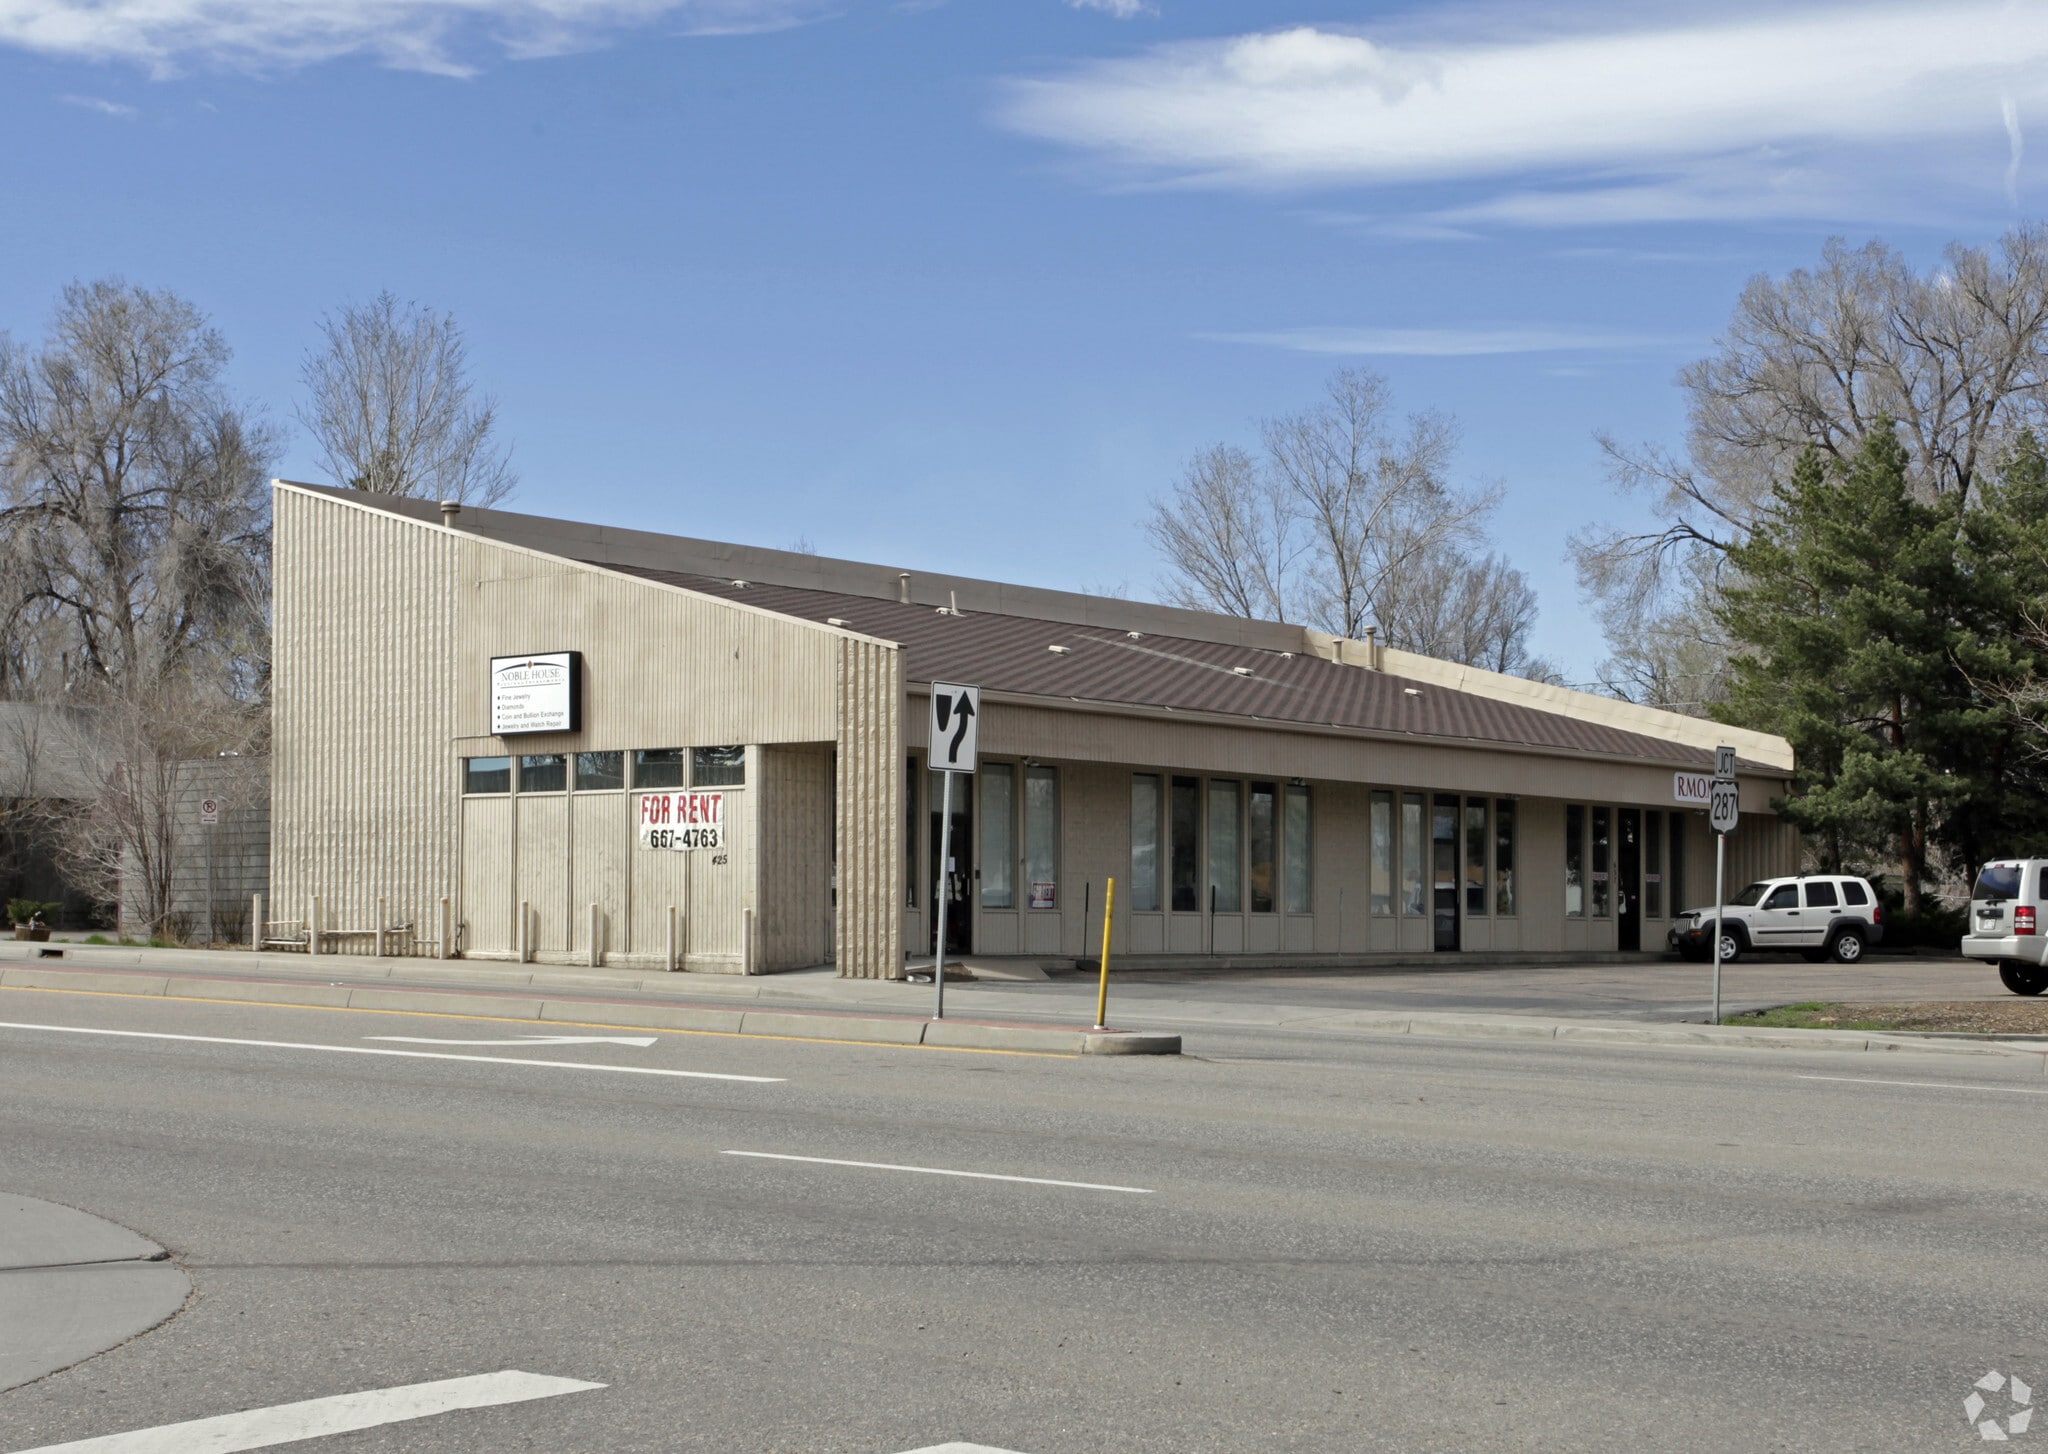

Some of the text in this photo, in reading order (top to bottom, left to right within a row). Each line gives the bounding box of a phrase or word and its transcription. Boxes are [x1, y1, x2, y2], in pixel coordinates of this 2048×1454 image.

[501, 668, 560, 682] NOBLE HOUSE
[540, 711, 564, 719] Exchange
[1718, 752, 1734, 775] JCT
[641, 794, 722, 825] FOR RENT
[1713, 792, 1736, 820] 287
[650, 828, 718, 848] 667-4763
